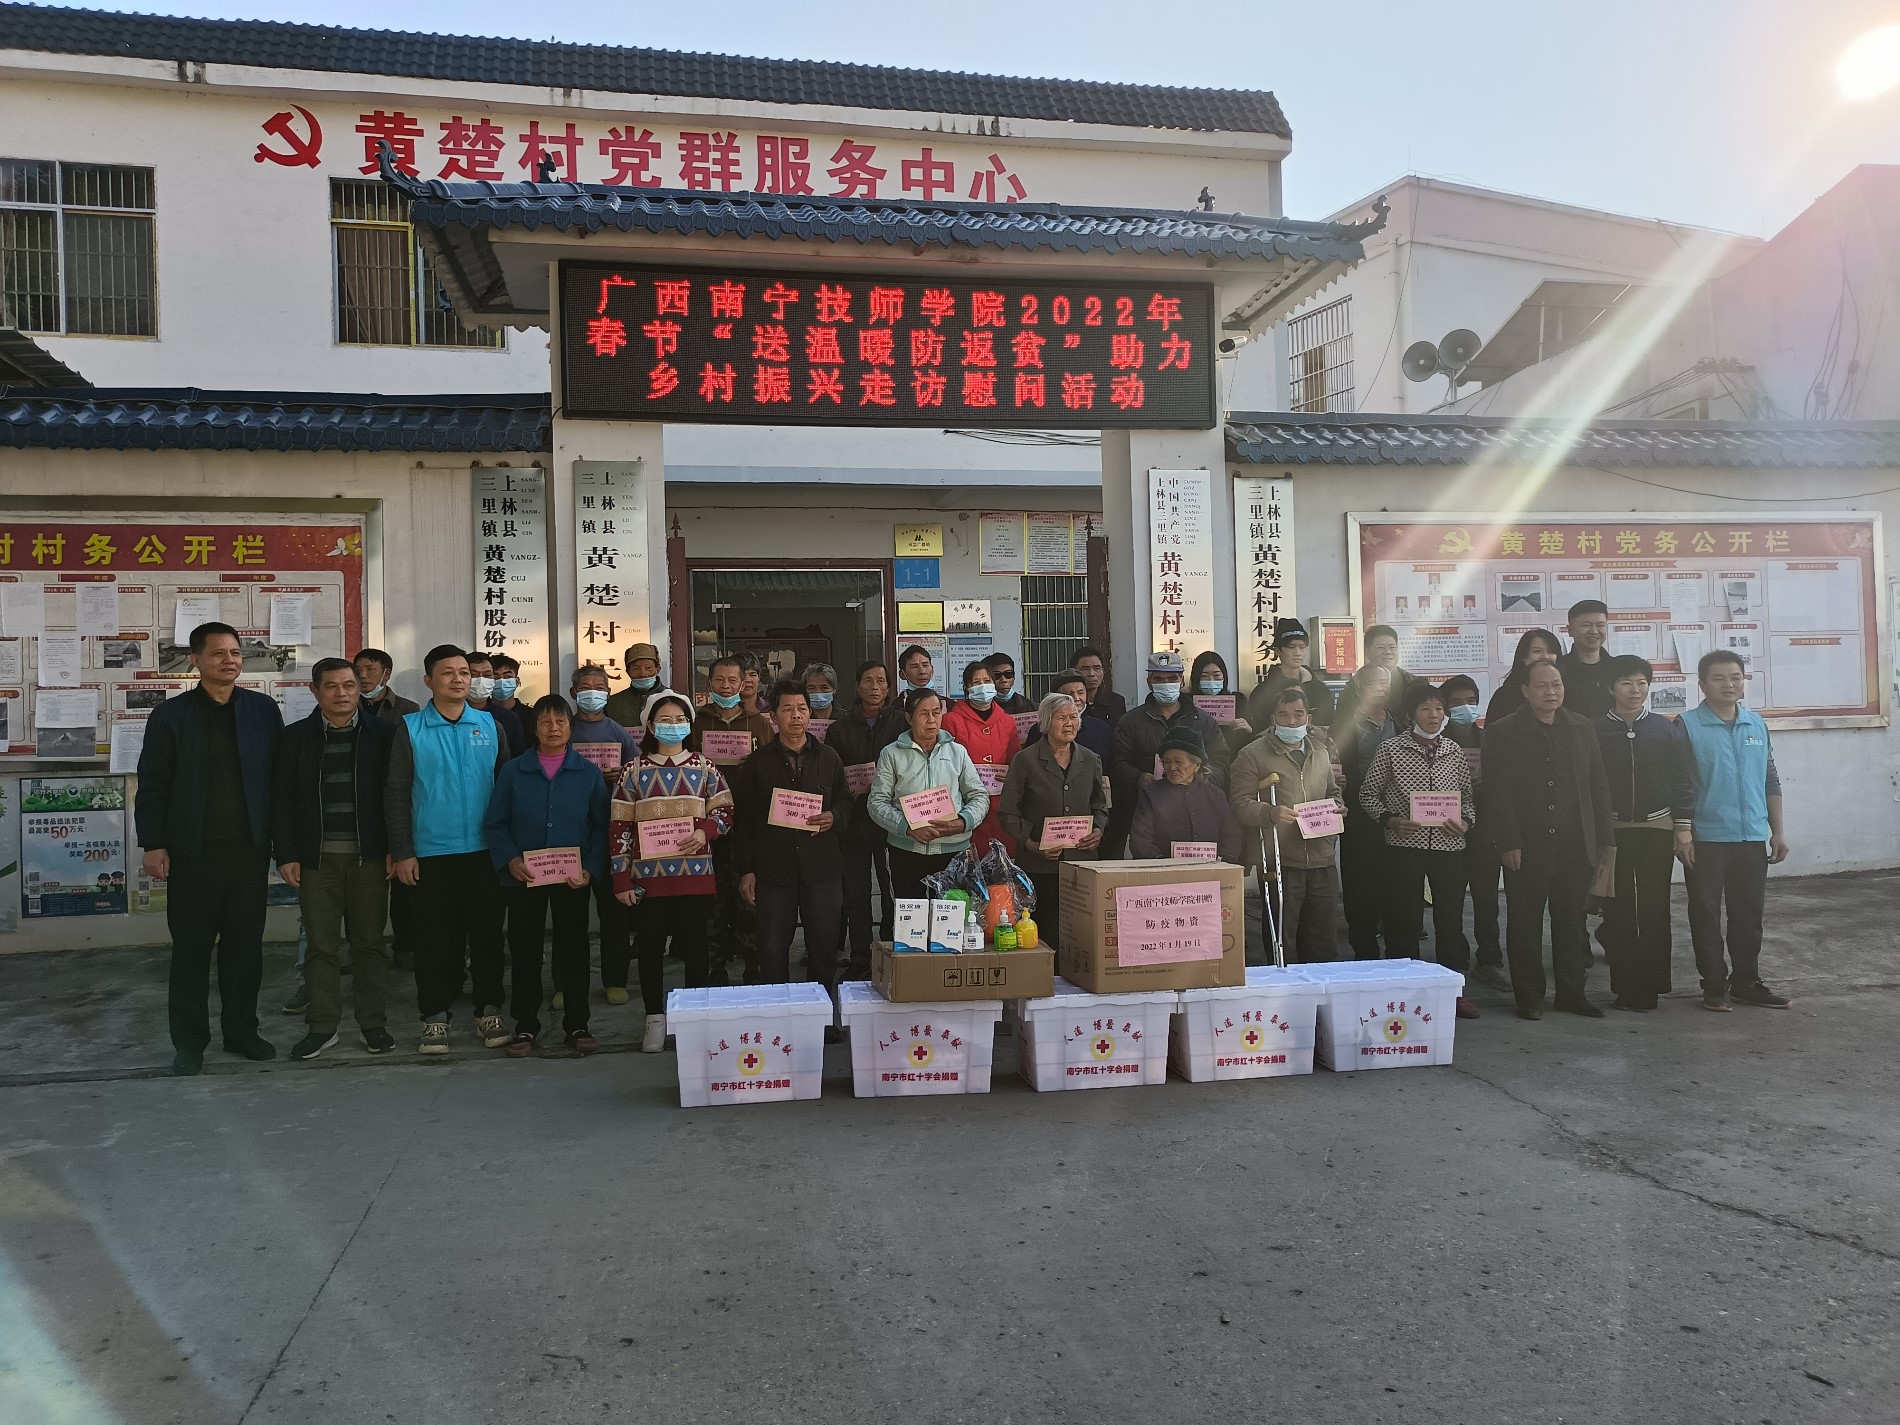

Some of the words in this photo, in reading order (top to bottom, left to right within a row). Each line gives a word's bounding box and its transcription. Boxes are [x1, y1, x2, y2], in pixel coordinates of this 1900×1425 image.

[354, 108, 1027, 204] 黄楚村党群服务中心
[597, 274, 1183, 328] 广西南宁技师学院2022年
[585, 317, 1193, 370] 春节“送温暖防返贫”助力
[646, 360, 1146, 410] 乡村振兴走访慰问活动
[480, 477, 498, 538] 三里镇
[501, 475, 518, 538] 上林县
[581, 473, 597, 535] 三里镇
[600, 471, 616, 535] 上林县
[1156, 477, 1167, 545] 上林县三里镇
[1169, 477, 1181, 545] 中国共产党
[1248, 485, 1264, 539] 三里镇
[1266, 485, 1282, 539] 上林县
[1500, 528, 1791, 557] 黄楚村党务公开栏
[483, 544, 507, 656] 黄楚村股份
[1125, 893, 1213, 909] 广西南宁技师学院捐赠
[1145, 916, 1199, 930] 防疫物资
[881, 1072, 959, 1083] 南宁市红十字会捐赠
[1066, 1064, 1139, 1076] 南宁市红十字会捐赠
[1216, 1054, 1286, 1067] 南宁市红十字会捐赠
[1361, 1045, 1428, 1056] 南宁市红十字会捐赠
[711, 1078, 791, 1091] 南宁市红十字会捐赠
